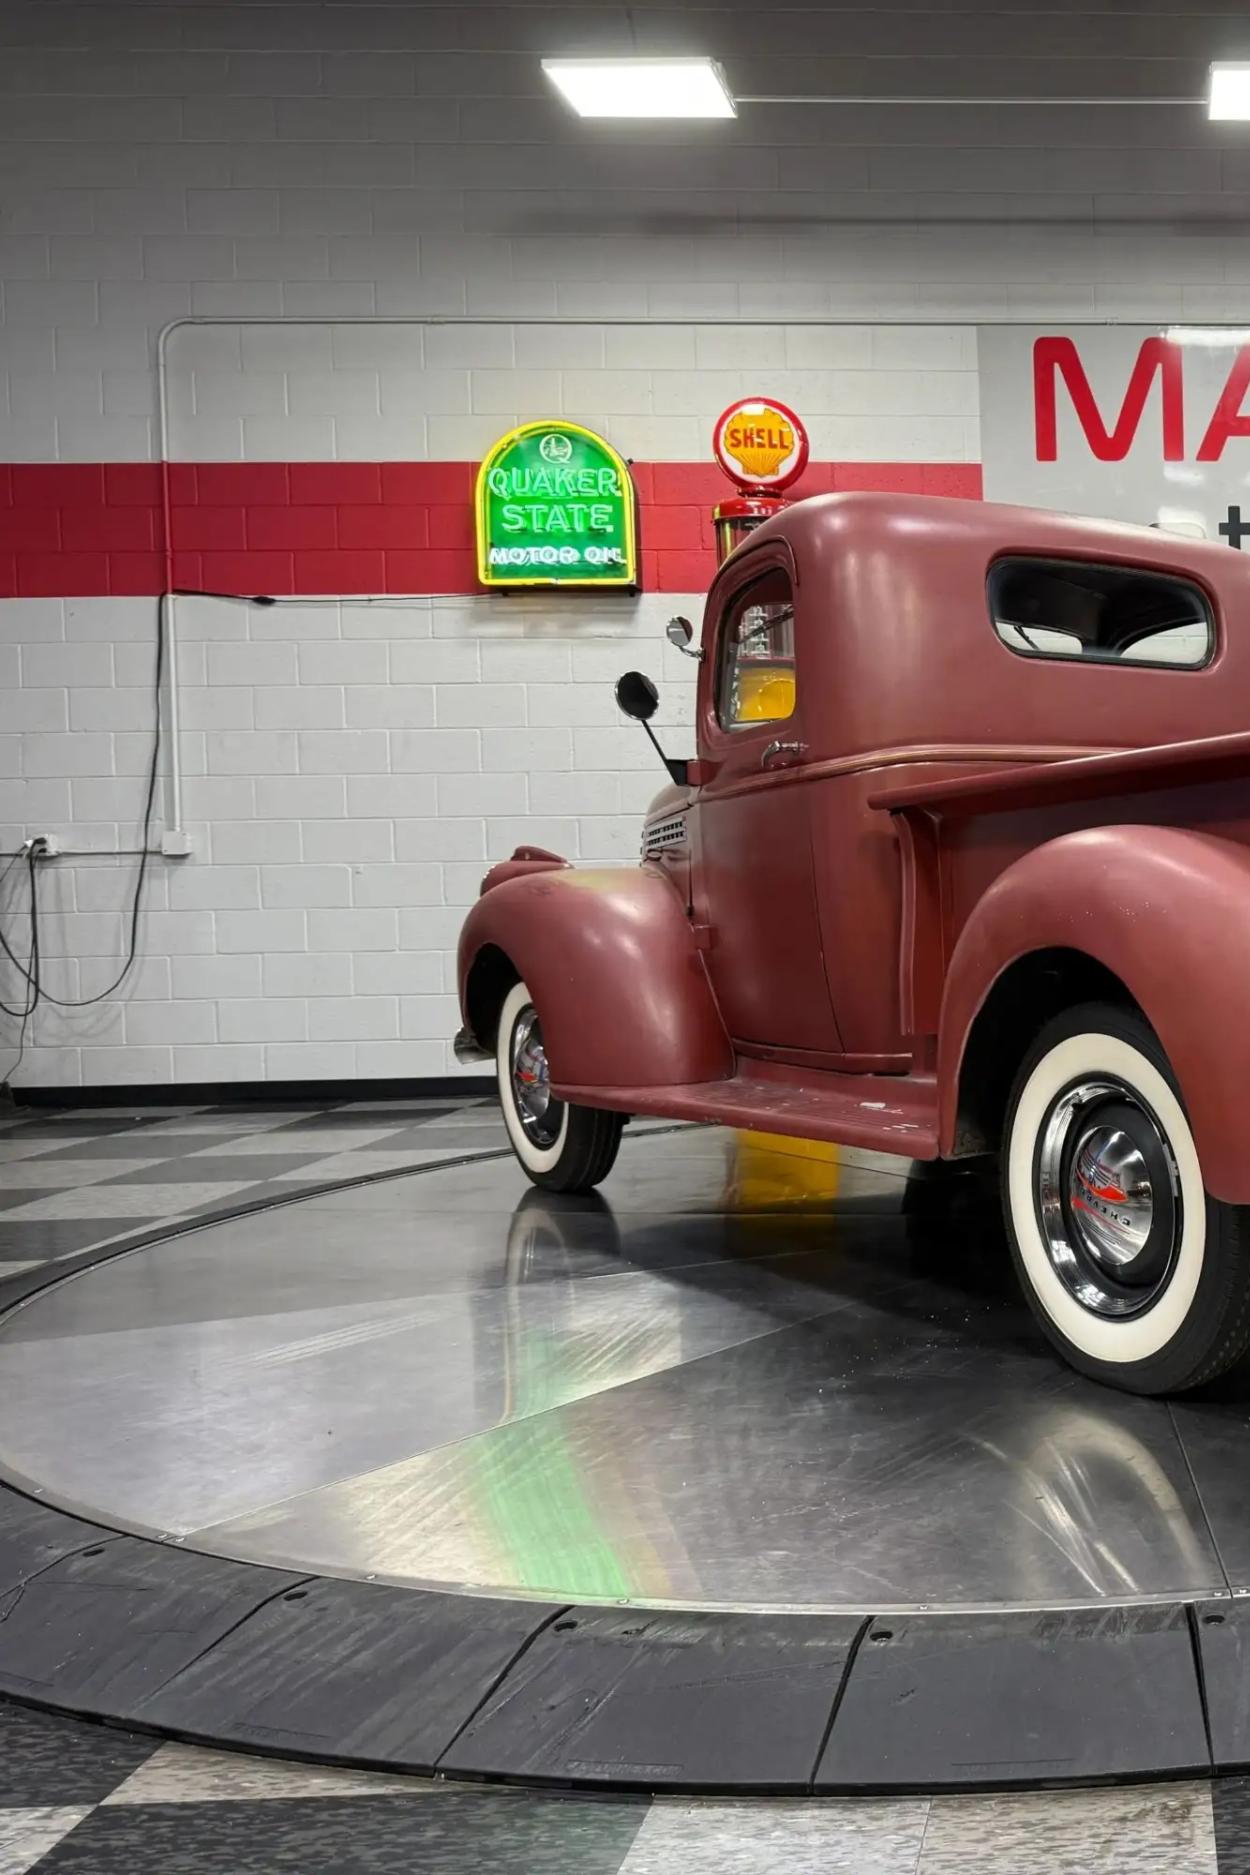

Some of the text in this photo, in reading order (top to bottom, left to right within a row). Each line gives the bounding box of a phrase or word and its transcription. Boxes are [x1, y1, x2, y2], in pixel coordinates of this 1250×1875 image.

[729, 428, 790, 450] SHELL
[488, 466, 623, 501] QUAKER
[502, 504, 614, 533] STATE
[489, 546, 627, 566] MOTOR OIL
